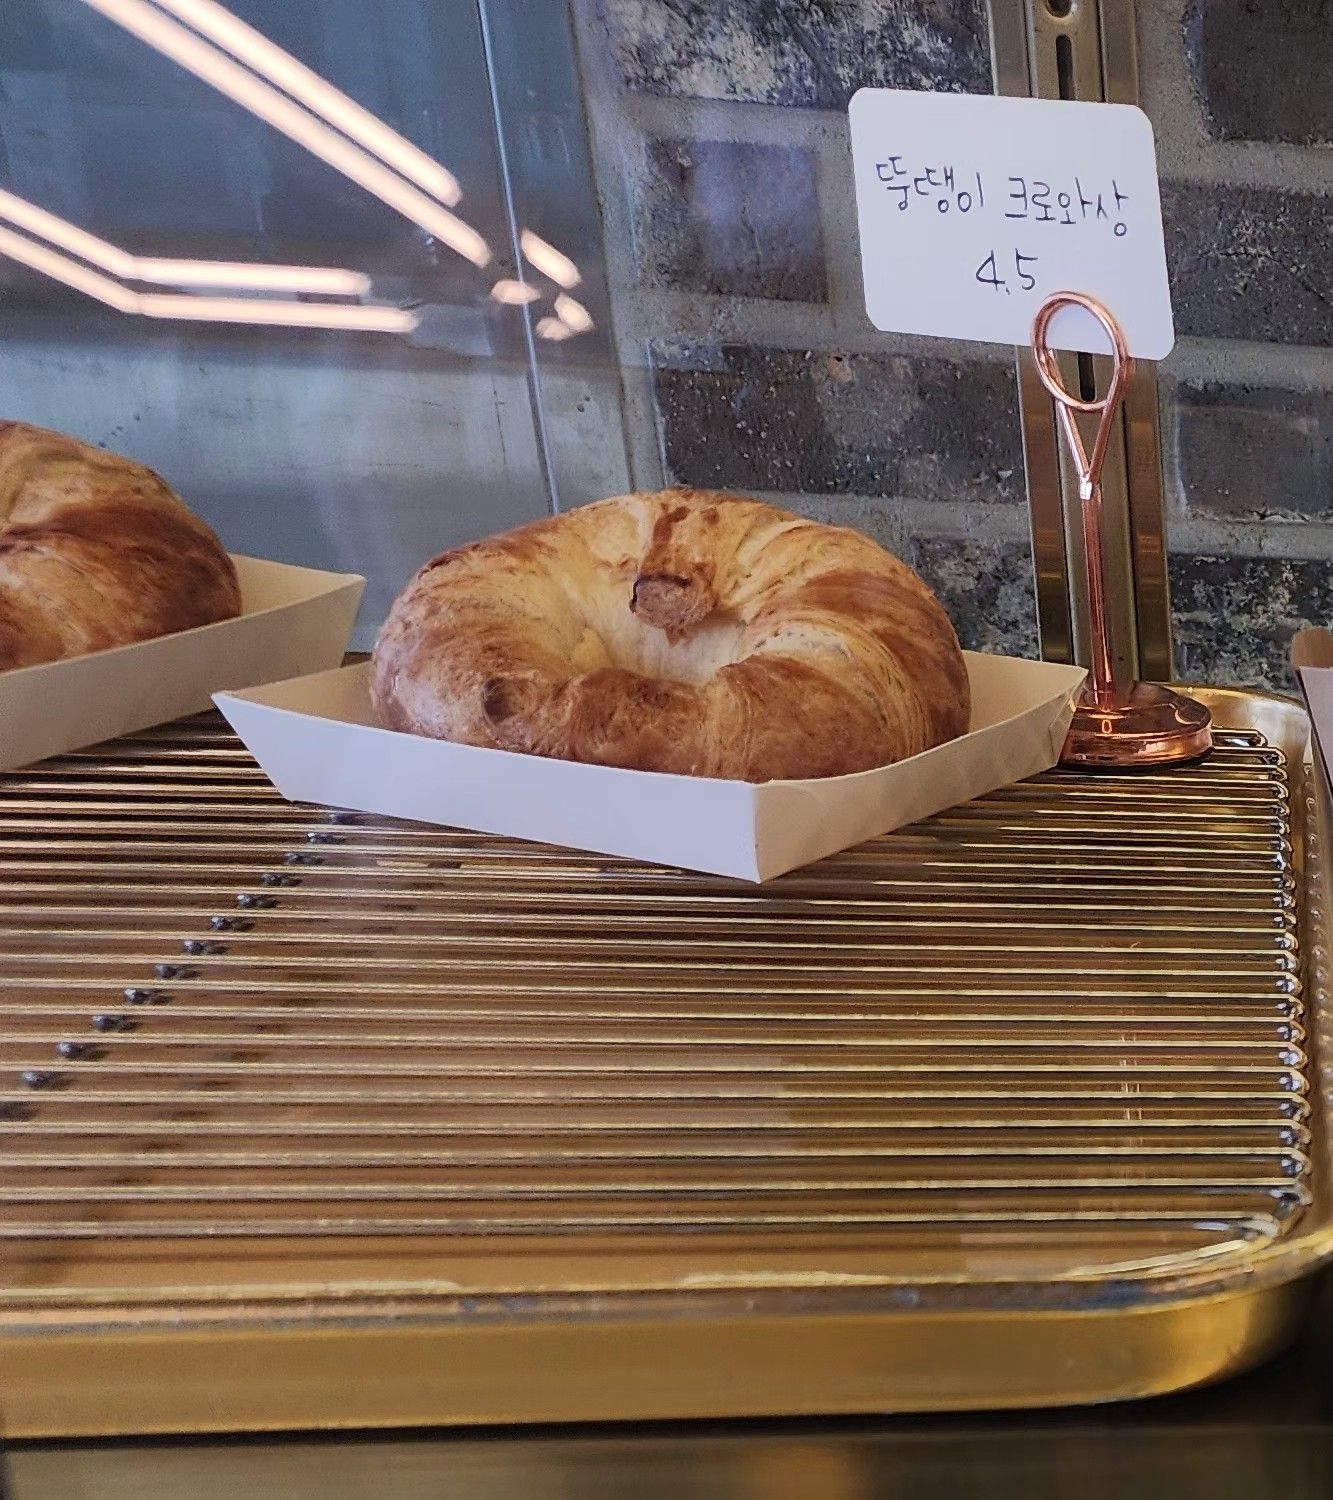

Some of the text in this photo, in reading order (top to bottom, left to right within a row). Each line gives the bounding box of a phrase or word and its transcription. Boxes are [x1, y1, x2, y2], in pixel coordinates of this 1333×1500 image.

[875, 155, 1130, 237] 뚱땡이 크로와상
[975, 247, 1039, 295] 4.5
